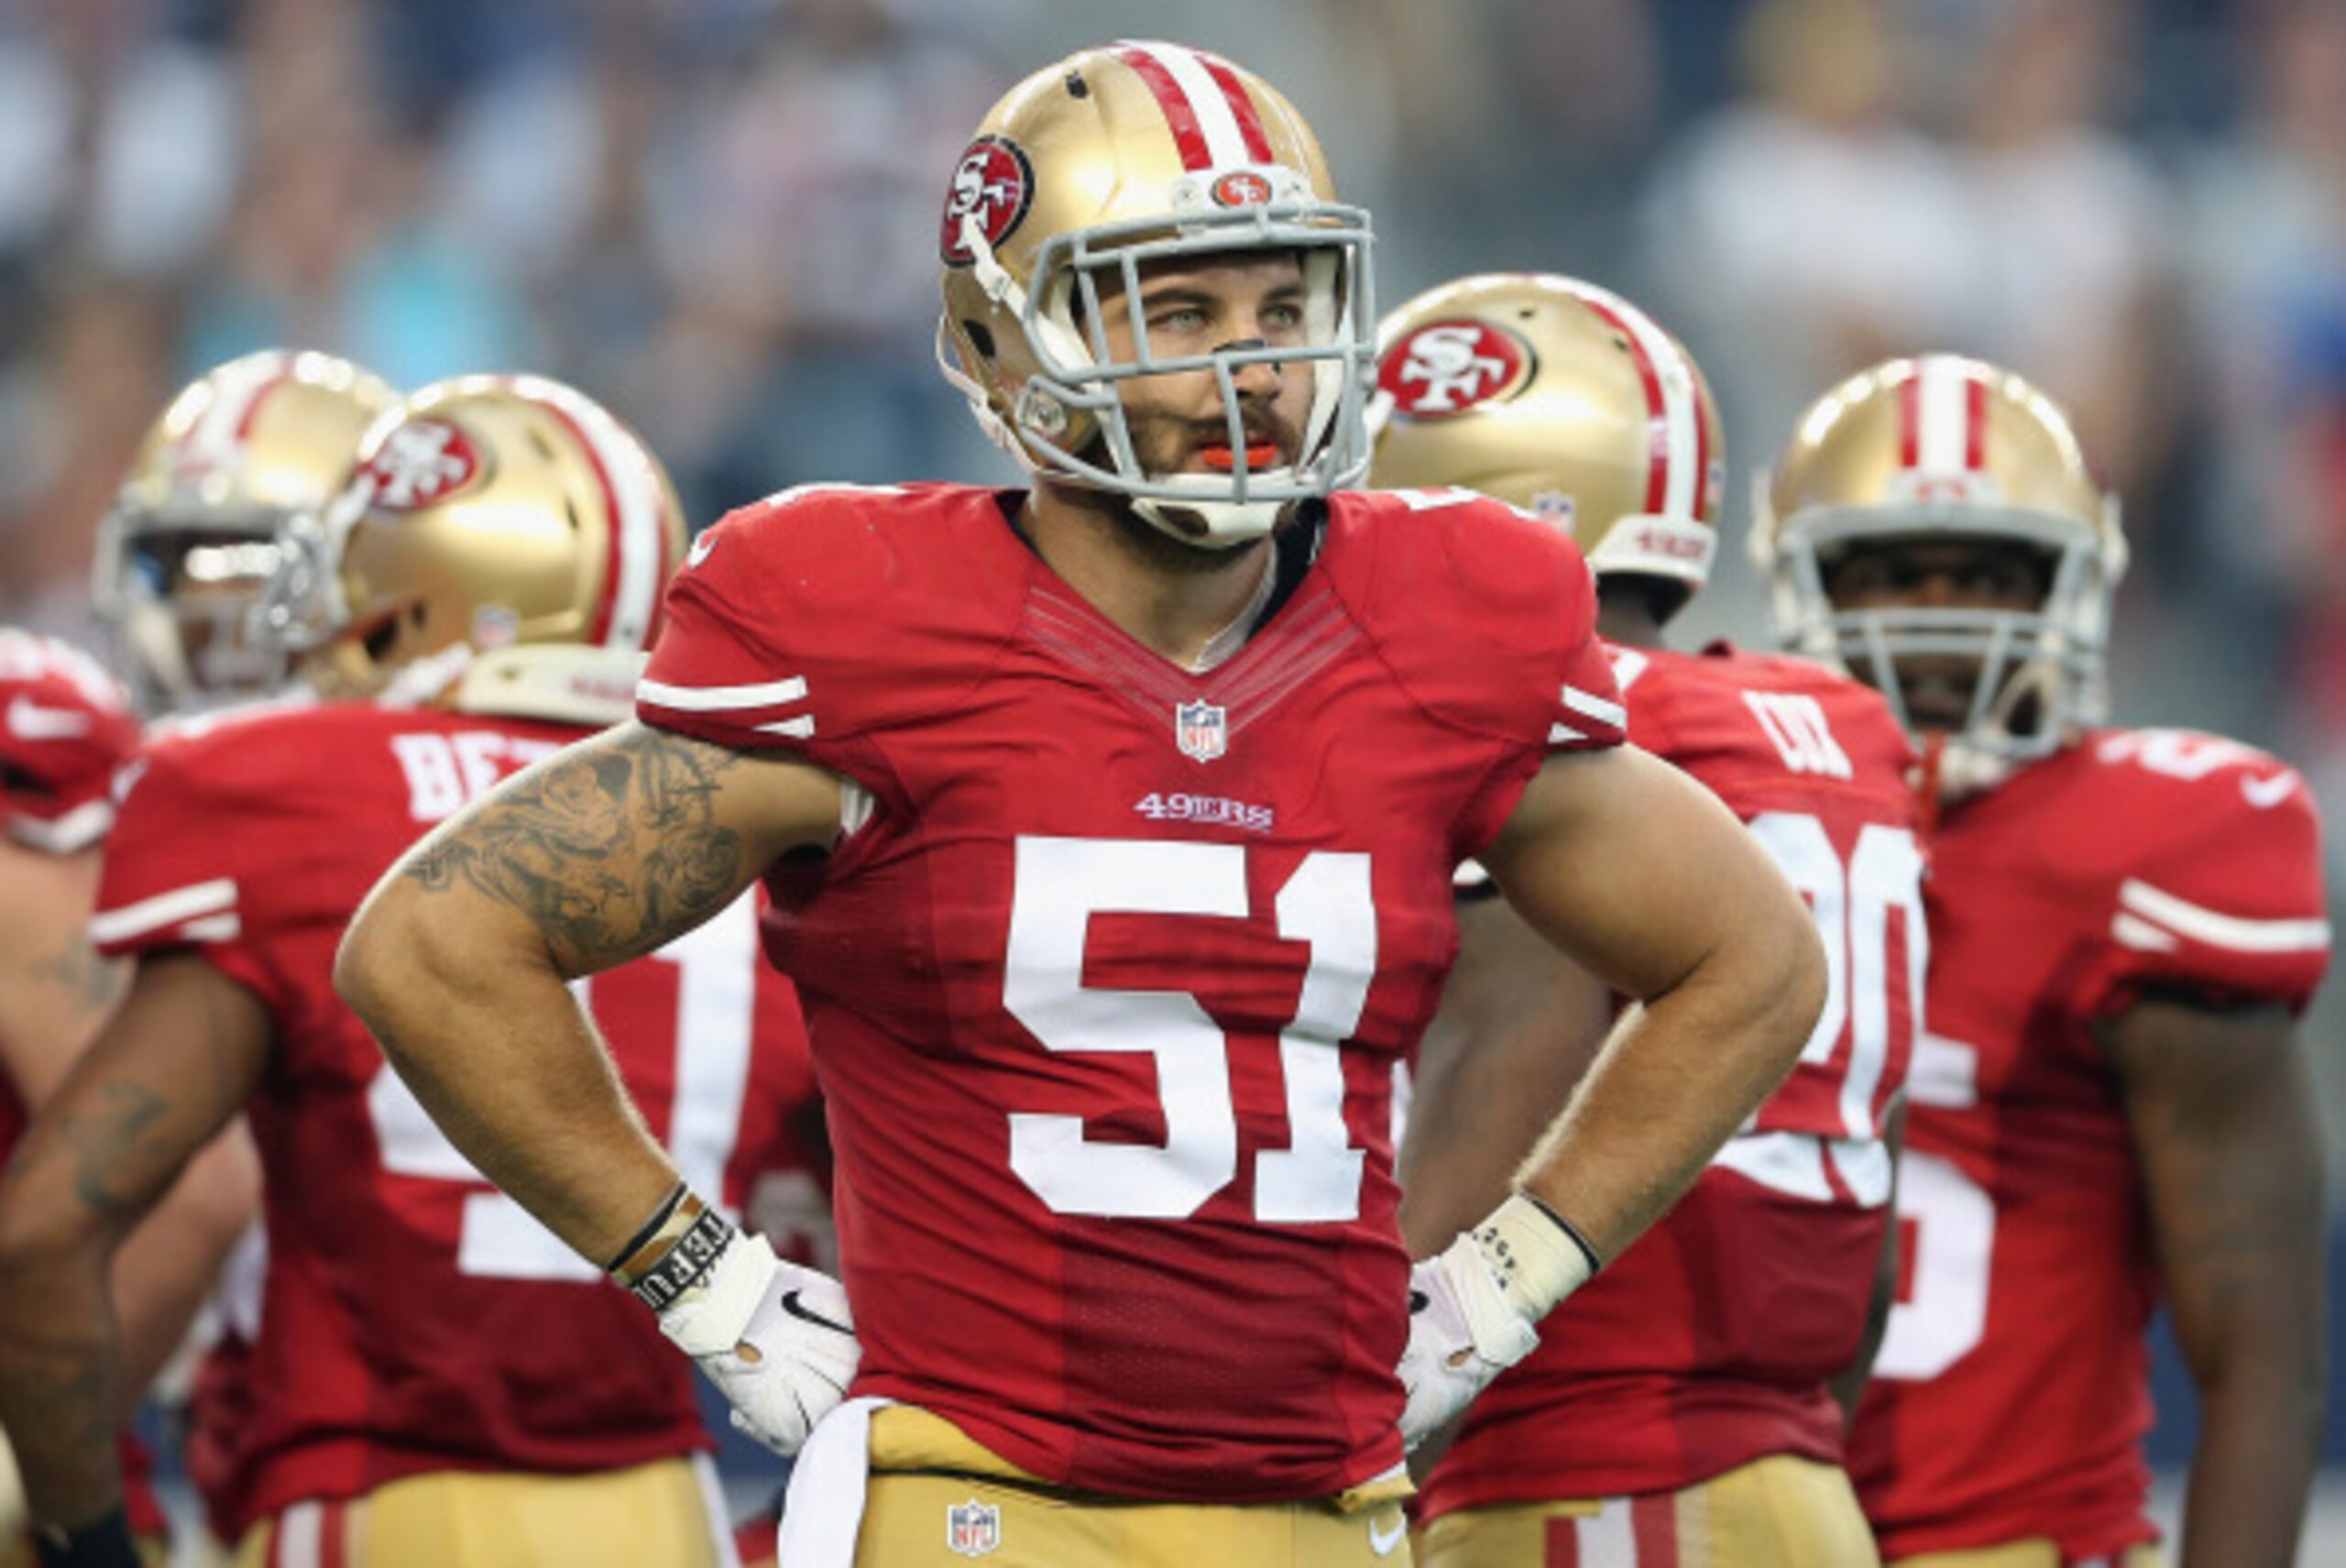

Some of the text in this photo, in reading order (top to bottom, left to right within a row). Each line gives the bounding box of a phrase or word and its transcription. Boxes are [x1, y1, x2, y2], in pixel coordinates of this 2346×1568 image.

[1400, 326, 1507, 411] SF
[1134, 793, 1274, 834] 49ERS
[1003, 834, 1376, 1223] 51
